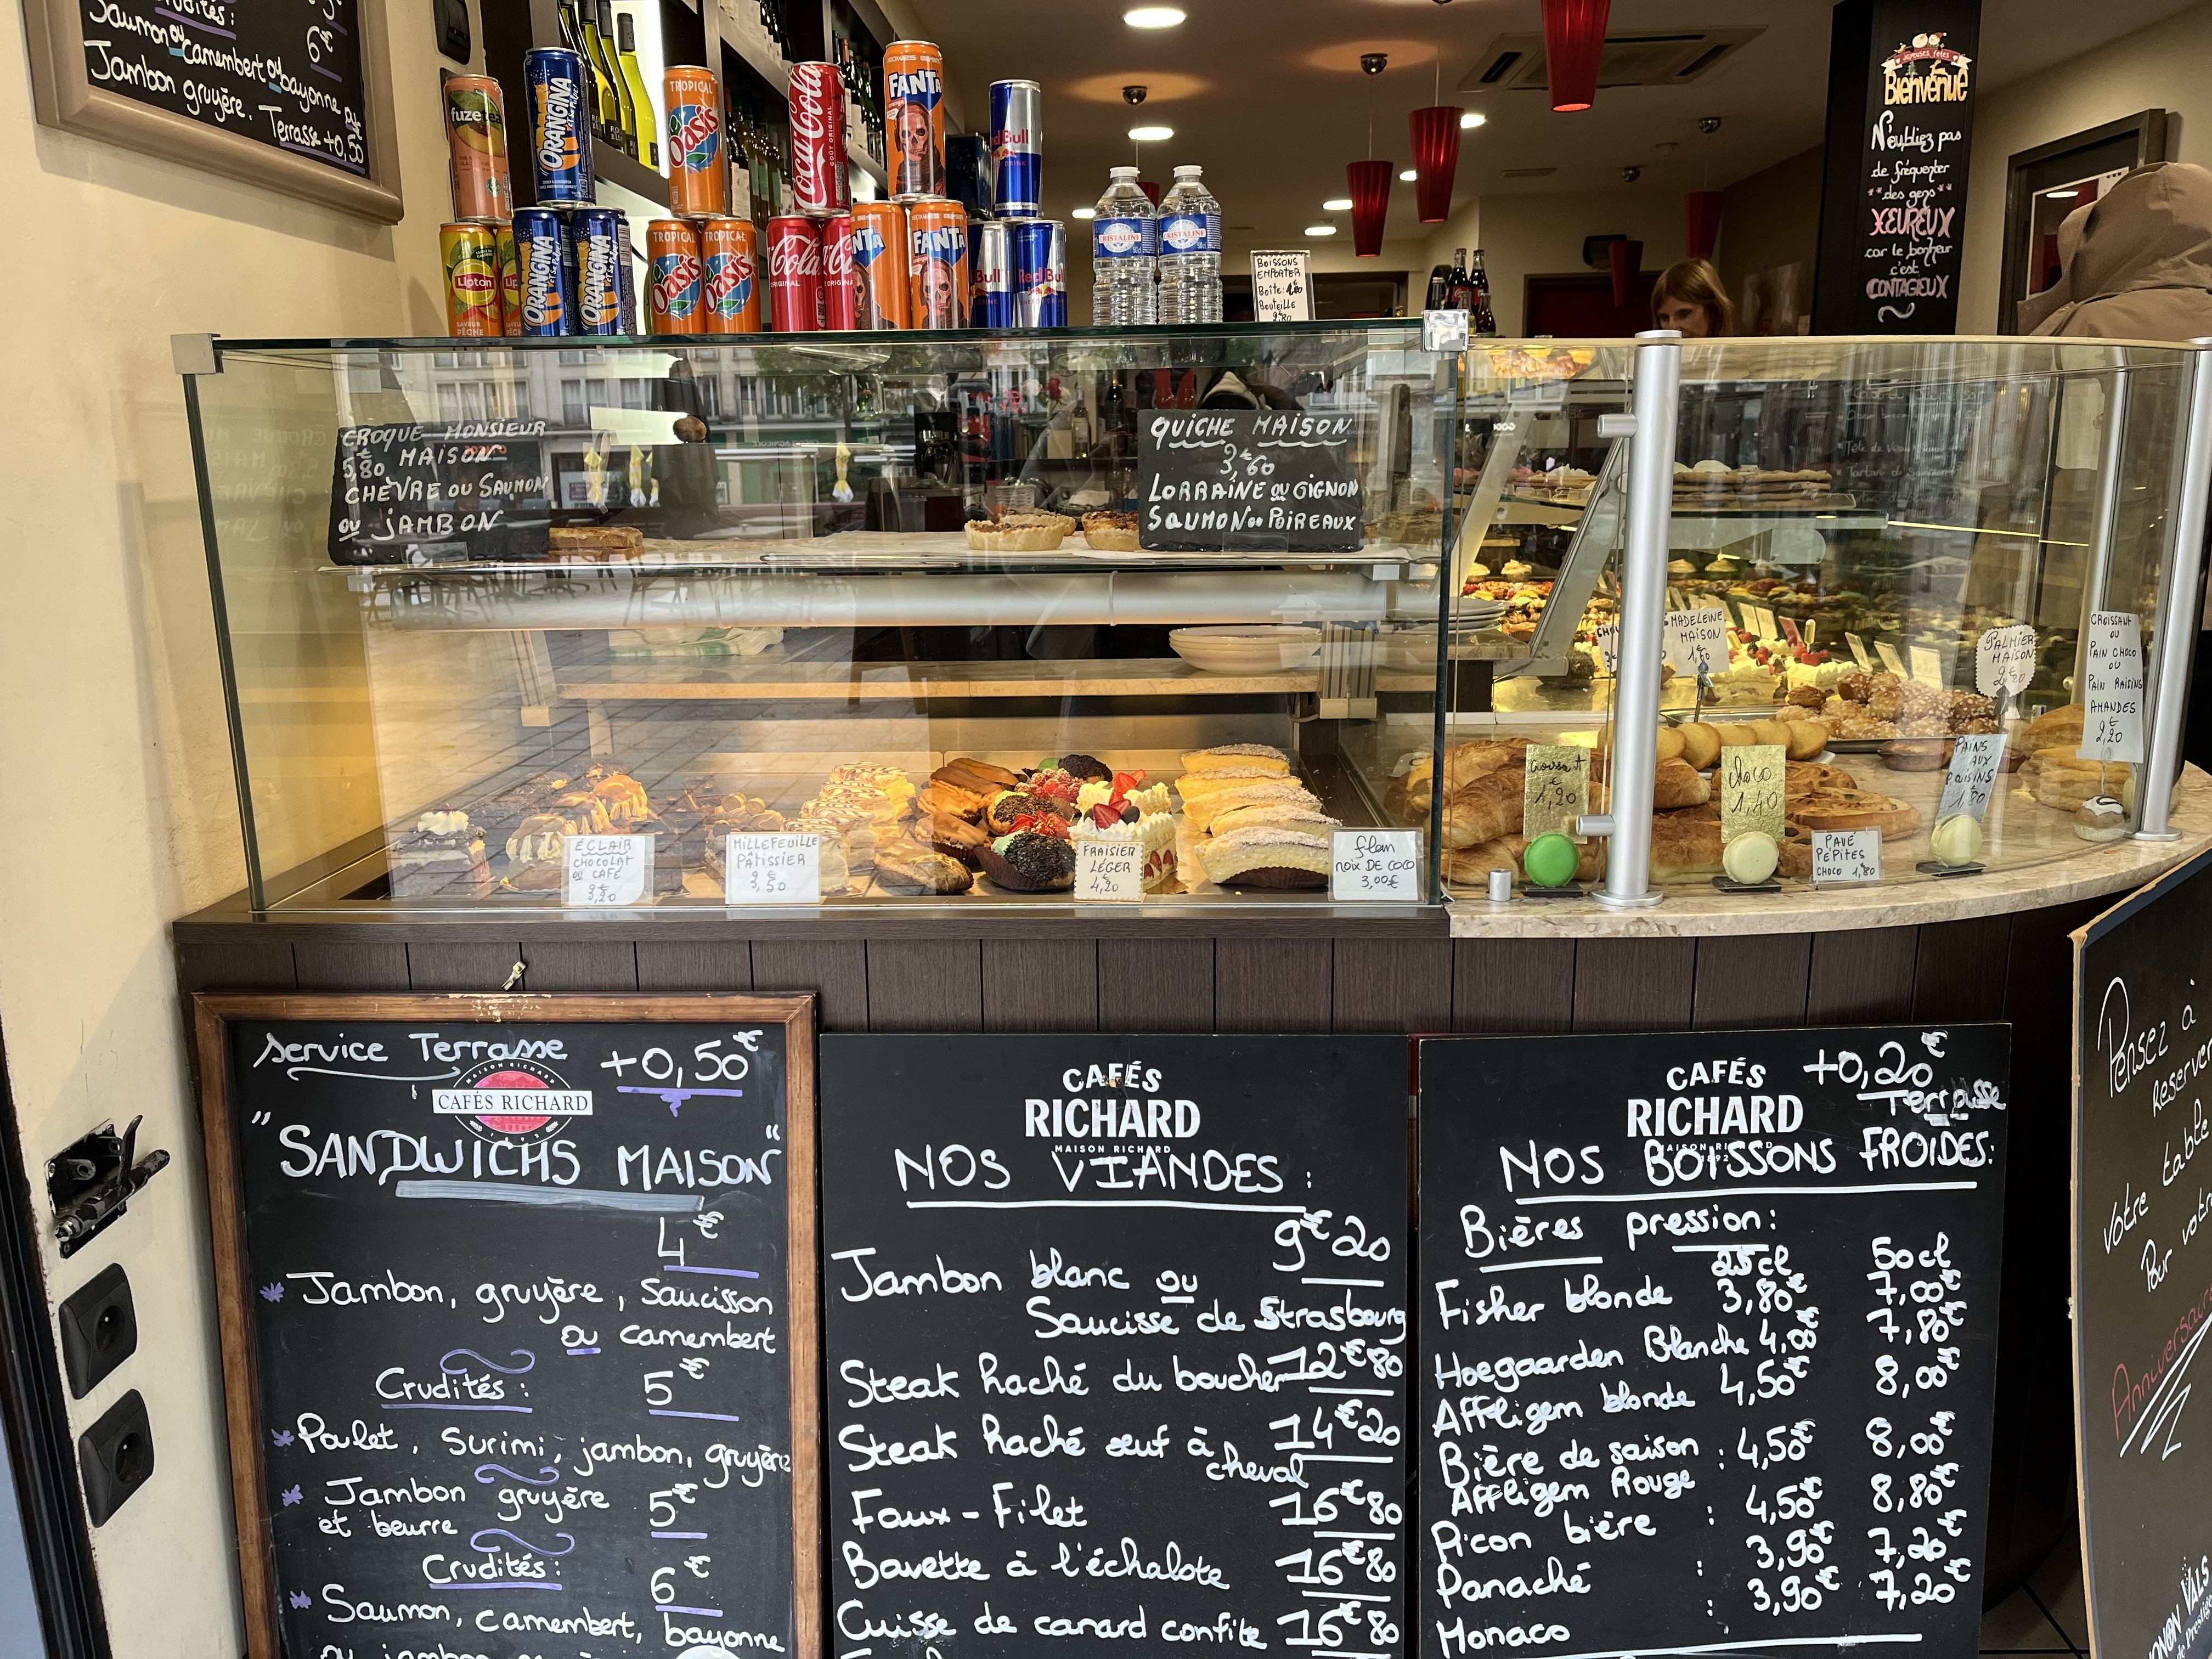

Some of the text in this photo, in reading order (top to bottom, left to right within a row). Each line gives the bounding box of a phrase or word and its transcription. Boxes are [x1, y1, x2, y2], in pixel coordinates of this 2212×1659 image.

[182, 39, 267, 83] camembert
[279, 70, 341, 114] bayonne
[669, 80, 713, 93] TROPICAL
[889, 70, 942, 98] FANTA
[1884, 67, 1970, 105] Bienvenue
[84, 40, 321, 146] Jambon Terrasse
[539, 77, 572, 169] ORANGINA
[668, 105, 720, 167] Oasis
[1002, 129, 1029, 144] Bull
[1938, 131, 1962, 152] pas
[1871, 160, 1950, 184] de fréquenter
[652, 230, 695, 243] TROPICAL
[704, 230, 746, 242] TROPICAL
[913, 228, 965, 254] FANTA
[1163, 230, 1205, 240] CRISTALINE
[1892, 243, 1904, 257] le
[457, 277, 492, 287] Lipton
[523, 236, 554, 323] ORANGINA
[580, 235, 611, 323] ORANGINA
[652, 253, 702, 315] Oasis
[705, 253, 753, 314] Oasis
[975, 268, 1001, 283] Bull
[1019, 267, 1042, 283] Red
[1257, 267, 1301, 279] EMPORTER
[458, 328, 484, 336] PÊCHE
[342, 419, 546, 452] CROQUE MONSIEUR
[1150, 413, 1352, 450] QUICHE MAISON
[399, 444, 503, 467] MAISON
[345, 472, 549, 504] CHÈVRE SAUMON
[1148, 473, 1358, 502] LORRAINE OIGNON
[1268, 507, 1356, 531] POIREAUX
[1671, 611, 1723, 627] MADELEINE
[1680, 628, 1720, 644] MAISON
[1984, 630, 2034, 651] PALMIER
[1992, 648, 2034, 664] MAISON
[2113, 647, 2137, 658] CHOCO
[2114, 678, 2142, 690] RAISINS
[2091, 700, 2136, 714] AMANDES
[734, 836, 818, 850] MILLEFEUILLE
[1083, 844, 1135, 857] FRAISIER
[1816, 848, 1865, 862] PÉPITES
[1825, 832, 1855, 848] PAVÉ
[574, 855, 634, 868] CHOCOLAT
[592, 866, 622, 879] CAFÉ
[1090, 859, 1131, 874] LÉGER
[1366, 861, 1383, 871] DE
[1816, 866, 1842, 876] CHOCO
[409, 1033, 567, 1060] Terrasse
[2097, 976, 2169, 1099] Pensez
[466, 1062, 555, 1084] MAISON RICHARD
[1062, 1060, 1163, 1093] CAFÉS
[1666, 1056, 1767, 1091] CAFÉS
[438, 1091, 588, 1111] CAFÉS RICHARD
[1627, 1094, 1804, 1138] RICHARD
[1024, 1098, 1201, 1138] RICHARD
[1055, 1144, 1105, 1154] MAISON
[2162, 1098, 2210, 1187] table
[894, 1143, 1011, 1192] NOS
[1499, 1137, 1837, 1193] NOS BOISSONS
[1459, 1204, 1584, 1259] Bières
[1871, 1231, 1952, 1271] 50cl
[2140, 1238, 2173, 1293] Pour
[830, 1246, 1198, 1302] Jambon blanc ou
[1025, 1288, 1407, 1346] Saucisse de Strasbourg
[1434, 1278, 1545, 1331] Fisher
[1563, 1273, 1674, 1314] blonde
[560, 1320, 777, 1355] ou camembert
[1434, 1322, 1750, 1393] Hoegaarden Blanche
[839, 1351, 1285, 1409] Steak haché du boucher
[1599, 1379, 1696, 1413] blonde
[837, 1412, 1086, 1473] Steak haché
[1205, 1441, 1308, 1488] cheval
[1438, 1433, 1700, 1488] Bière de saison
[324, 1476, 466, 1506] Jambon
[1610, 1465, 1696, 1500] Rouge
[370, 1509, 459, 1538] beurre
[1430, 1509, 1657, 1564] Picon bière
[841, 1536, 1231, 1590] Bavette à l'échalote
[1436, 1559, 1593, 1609] Panaché
[663, 1611, 786, 1659] bayonne
[836, 1597, 1268, 1650] Cuisse de canard confite
[1435, 1616, 1571, 1659] Monaco
